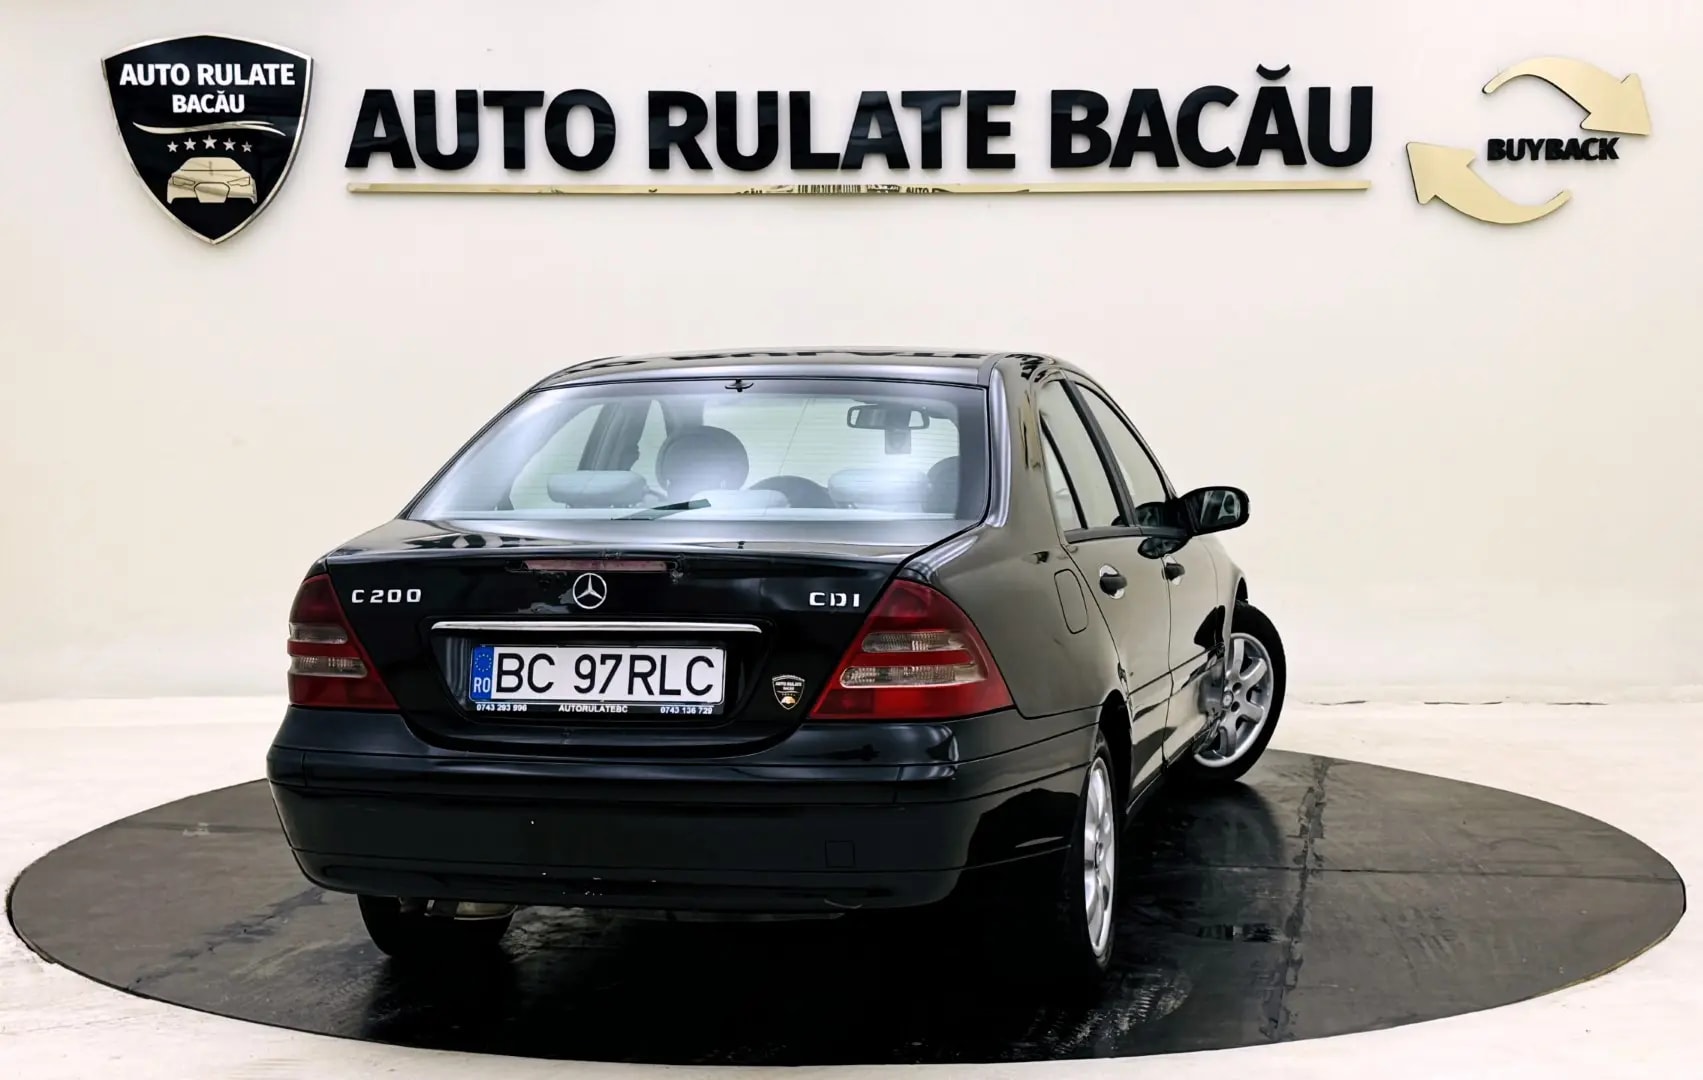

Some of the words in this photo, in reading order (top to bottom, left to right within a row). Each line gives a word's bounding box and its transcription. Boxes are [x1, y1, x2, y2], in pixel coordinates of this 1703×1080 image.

[120, 63, 190, 86] AUTO
[197, 63, 295, 86] RULATE
[172, 90, 245, 113] BACĂU
[344, 88, 617, 172] AUTO
[647, 89, 1016, 172] RULATE
[1049, 63, 1374, 170] BACĂU
[1487, 137, 1620, 162] BUYBACK
[809, 592, 860, 608] CDI
[473, 677, 491, 693] RO
[495, 653, 556, 694] BC
[558, 704, 628, 713] AUTORULATEBC
